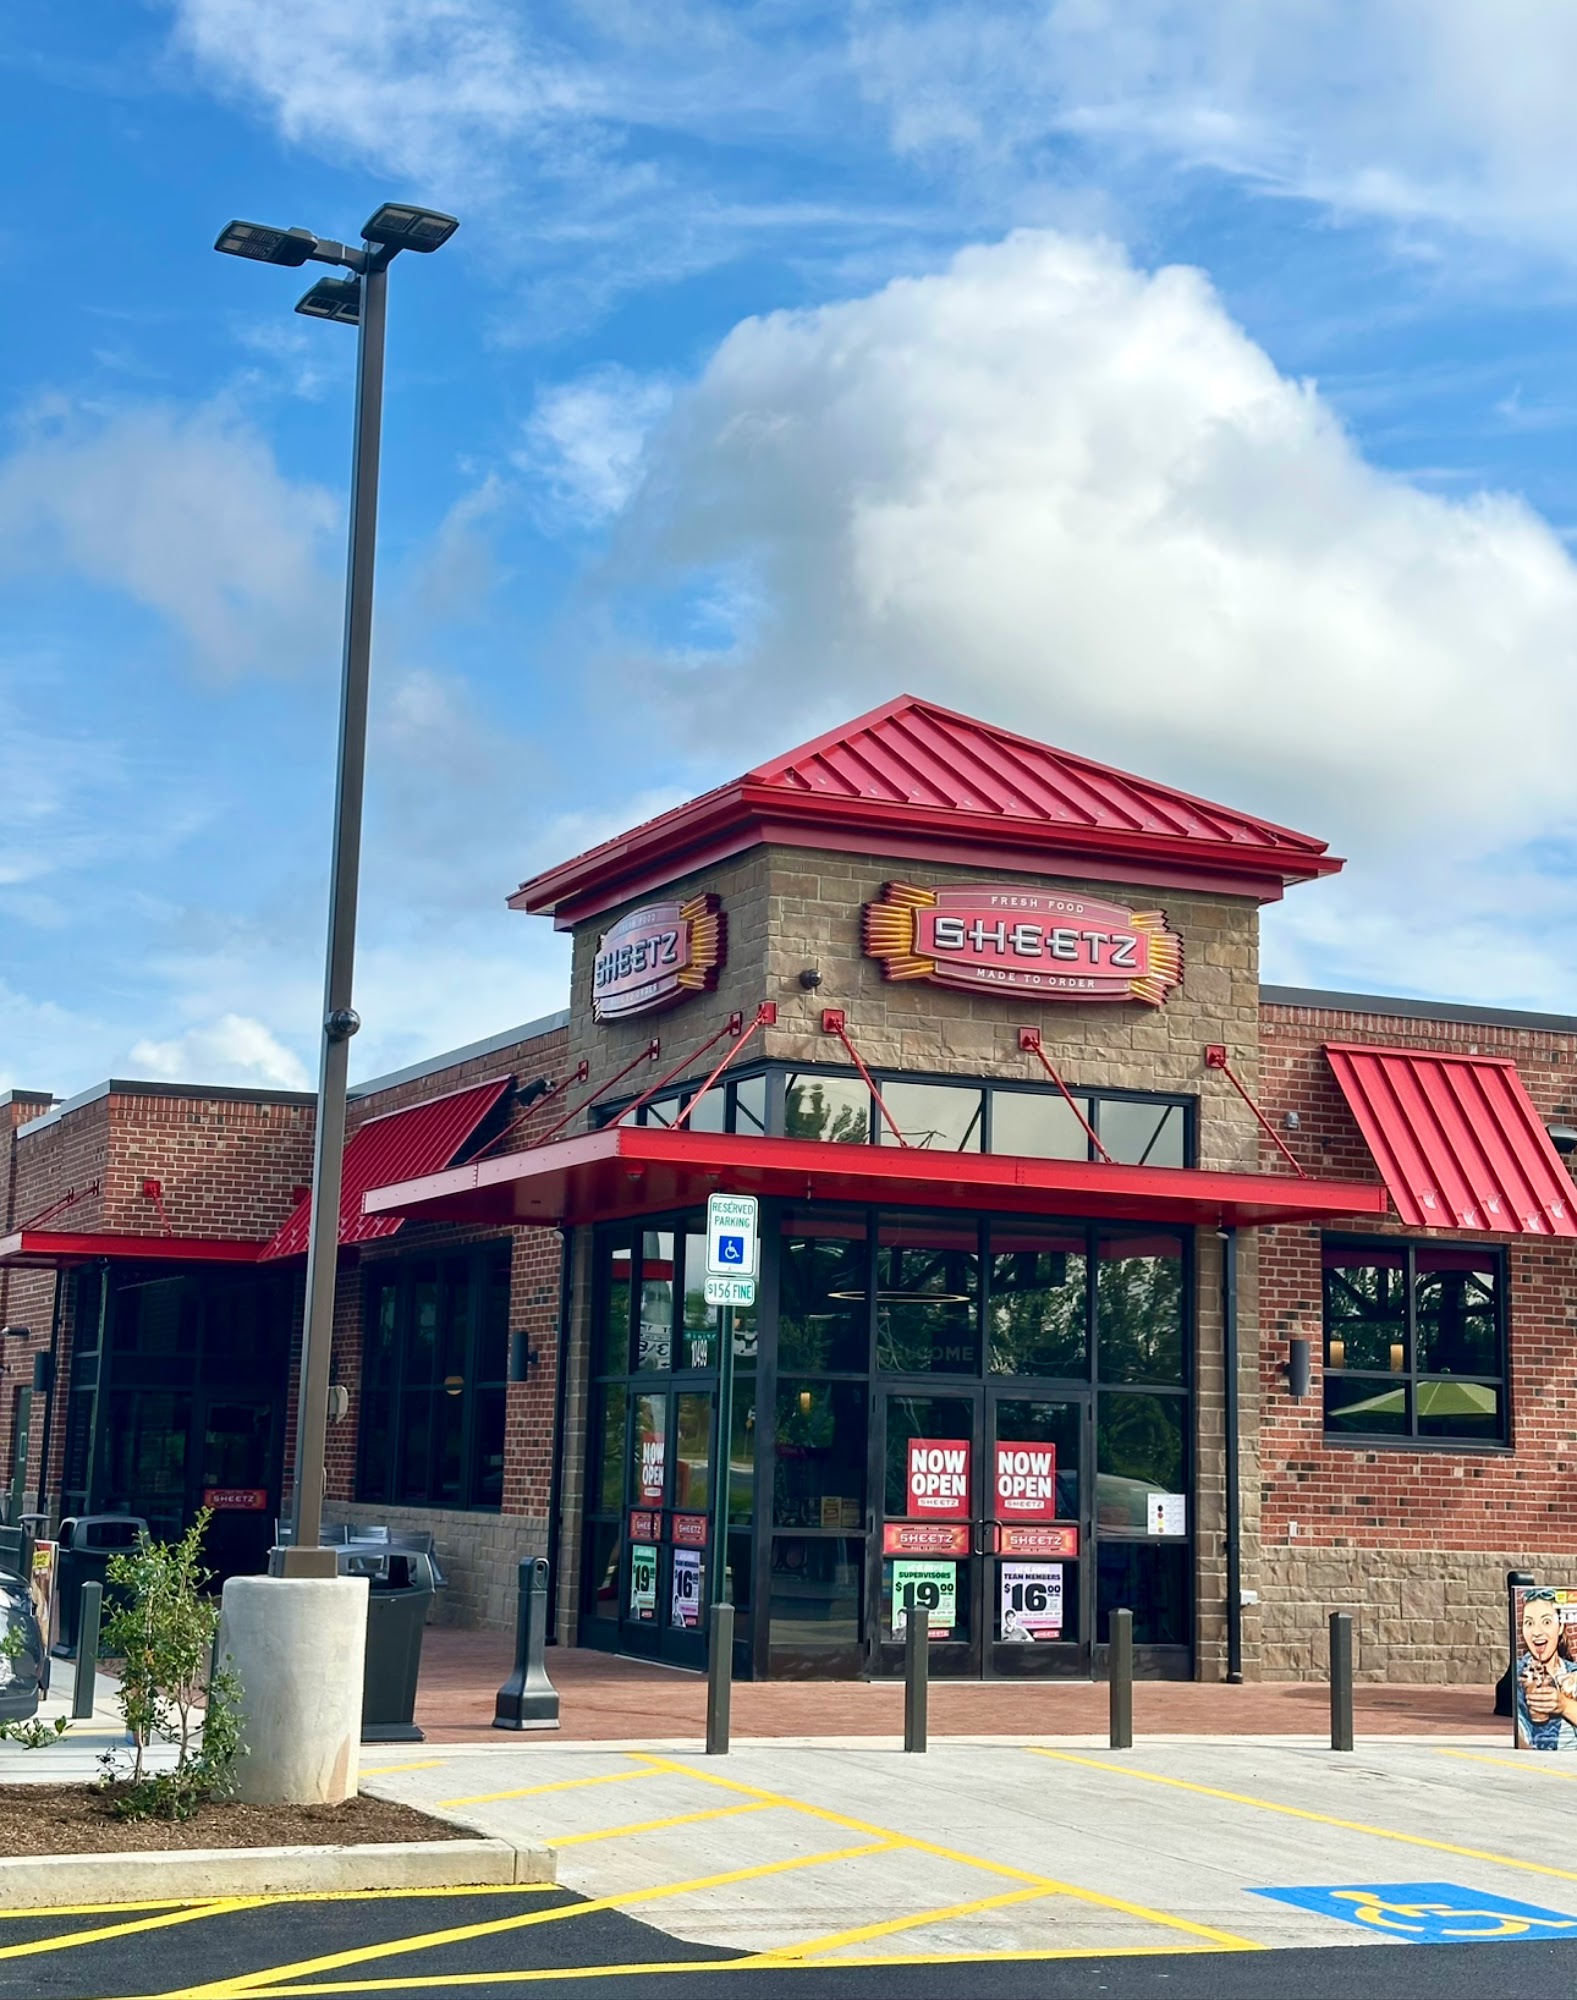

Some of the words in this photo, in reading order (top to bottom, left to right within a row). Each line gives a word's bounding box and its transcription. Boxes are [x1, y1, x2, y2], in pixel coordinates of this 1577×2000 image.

[991, 896, 1038, 908] FRESH
[1049, 900, 1084, 914] FOOD
[933, 917, 1137, 968] SHEETZ
[596, 930, 679, 988] SHEETZ
[976, 968, 1016, 982] MADE
[1024, 974, 1041, 984] TO
[1049, 977, 1095, 989] ORDER
[713, 1202, 754, 1215] RESERVED
[715, 1216, 750, 1228] PARKING
[708, 1283, 731, 1299] $156
[733, 1284, 752, 1299] FINE
[643, 1442, 664, 1464] NOW
[911, 1449, 966, 1474] NOW
[998, 1451, 1051, 1476] NOW
[642, 1465, 663, 1486] OPEN
[911, 1474, 966, 1496] OPEN
[998, 1476, 1051, 1498] OPEN
[636, 1521, 657, 1530] SHEEZ
[900, 1533, 953, 1544] SHEETZ
[1010, 1535, 1061, 1546] SHEETZ
